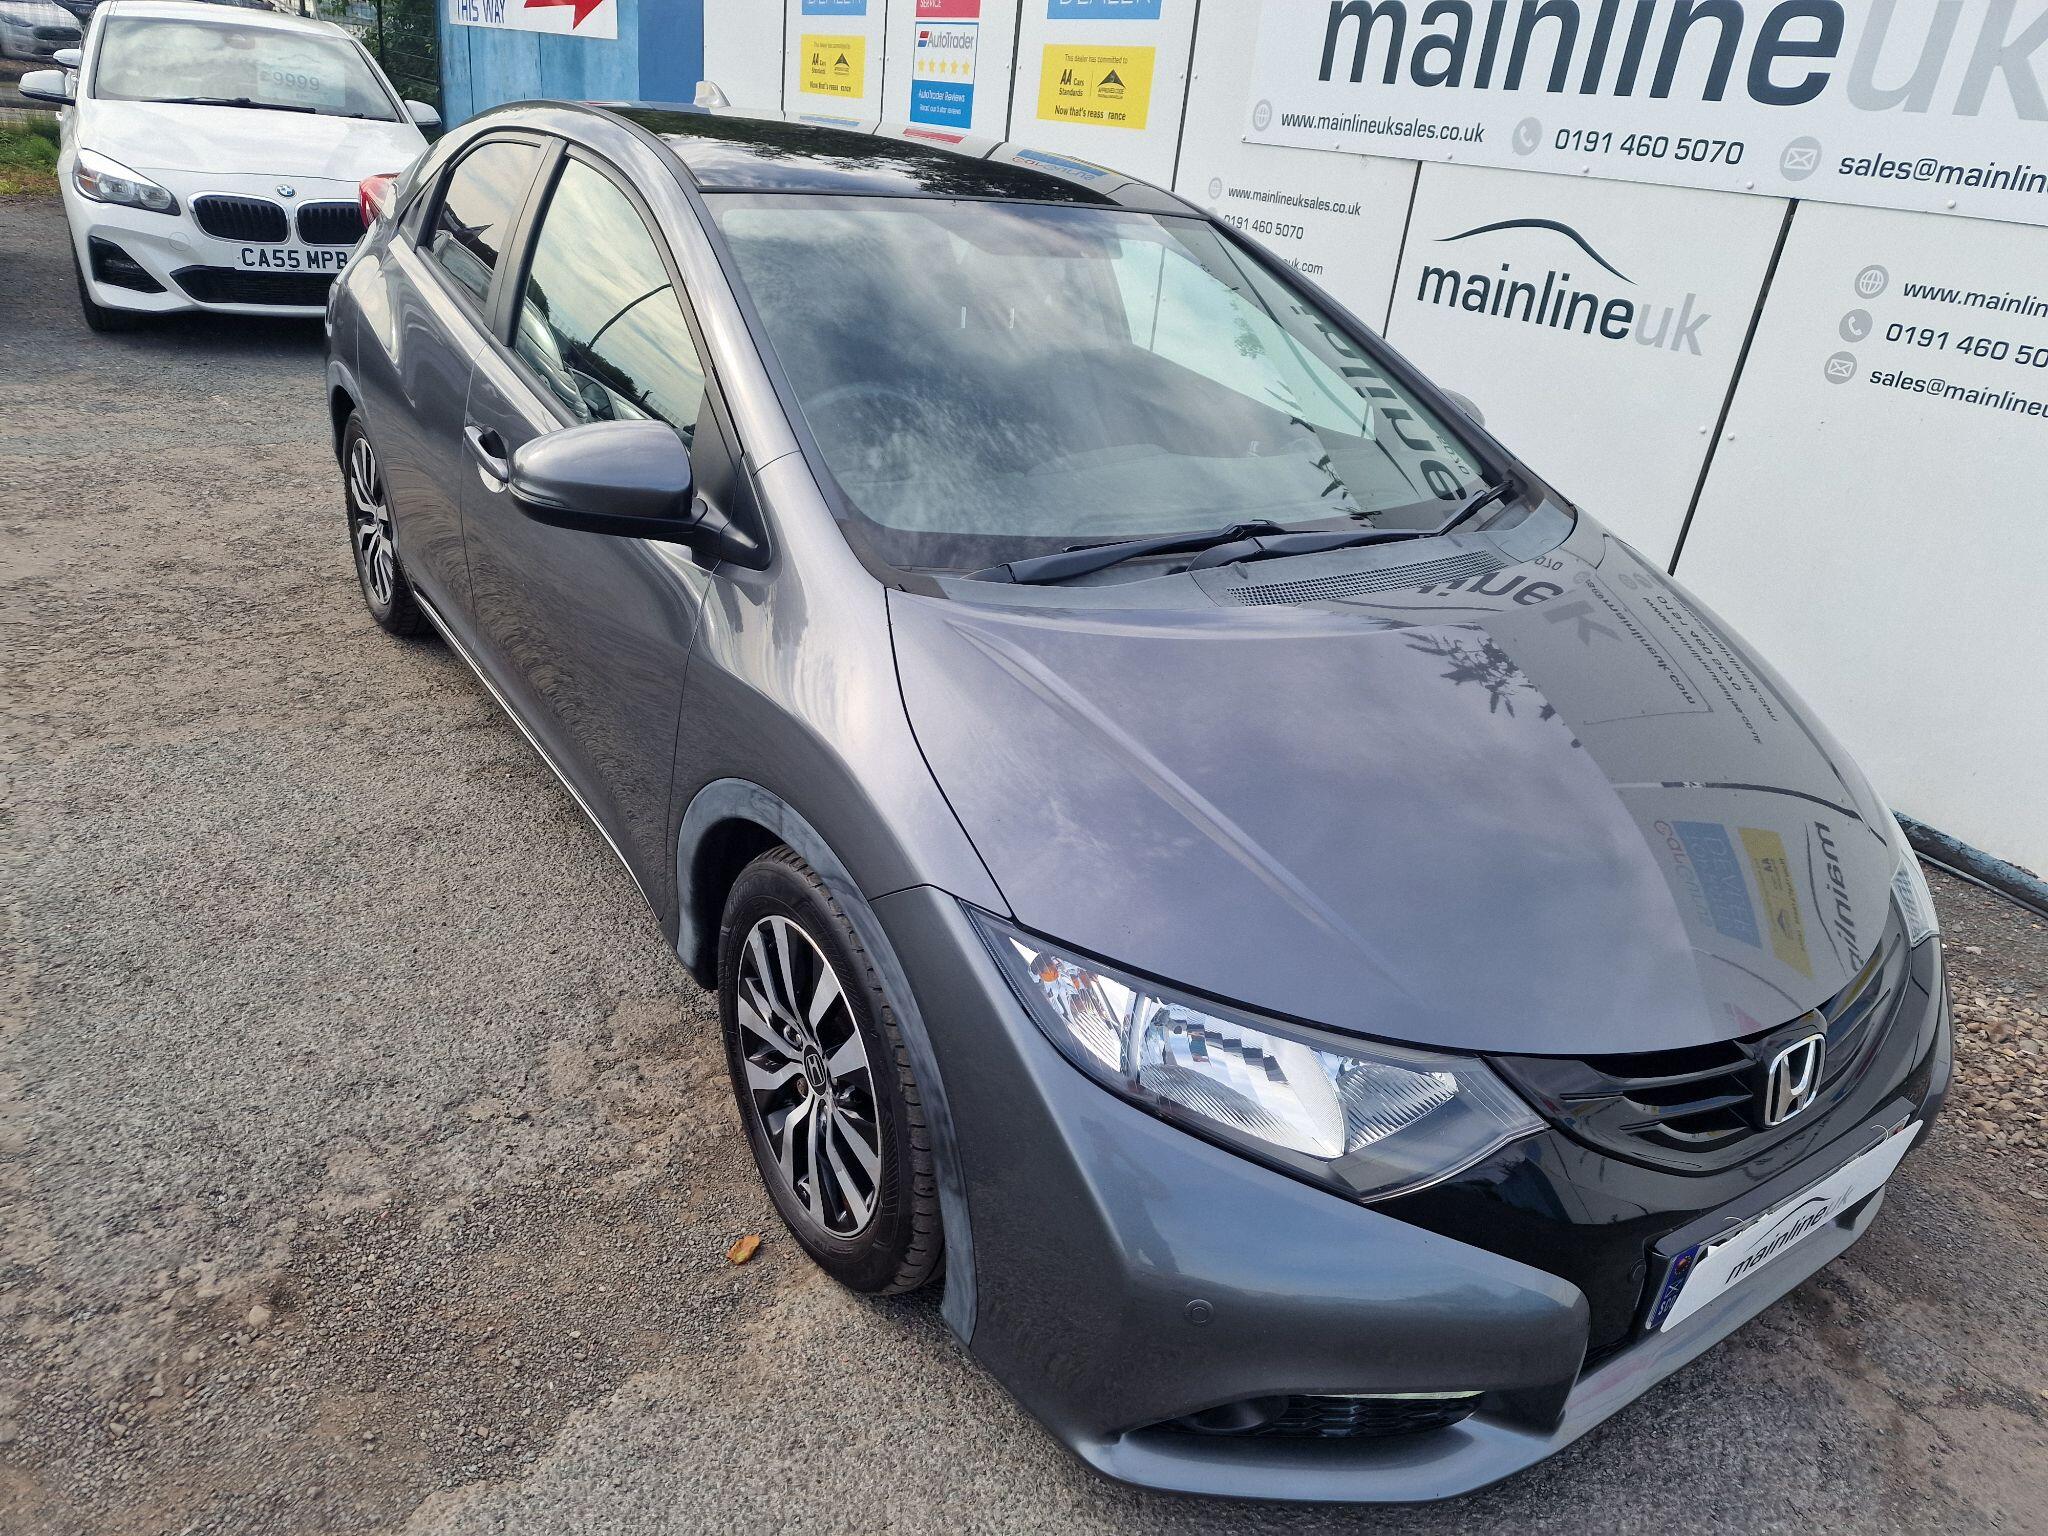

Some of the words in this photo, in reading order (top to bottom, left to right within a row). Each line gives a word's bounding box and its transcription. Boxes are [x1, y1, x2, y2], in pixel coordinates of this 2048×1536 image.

[457, 0, 479, 21] THIS
[482, 0, 505, 24] WAY
[927, 31, 974, 49] AutoTrader
[1060, 69, 1072, 85] AA
[1074, 78, 1085, 86] Cars
[1059, 88, 1083, 97] Standards
[1055, 105, 1068, 116] Now
[1069, 107, 1087, 118] that's
[1281, 112, 1485, 143] www.mainlineuksales.co.uk
[1555, 128, 1613, 154] 0191
[1620, 133, 1669, 159] 460
[1674, 137, 1745, 165] 5070
[1838, 153, 2048, 193] sales@mainlin
[1228, 187, 1361, 216] www.mainlineuksales.co.uk
[1251, 219, 1273, 234] 460
[1275, 222, 1304, 240] 5070
[241, 247, 301, 269] CA55
[306, 250, 349, 270] MPB
[1417, 262, 1712, 356] mainlineuk
[1886, 322, 1950, 350] 0191
[1956, 335, 2010, 361] 460
[1725, 1184, 1855, 1284] mainlineuk
